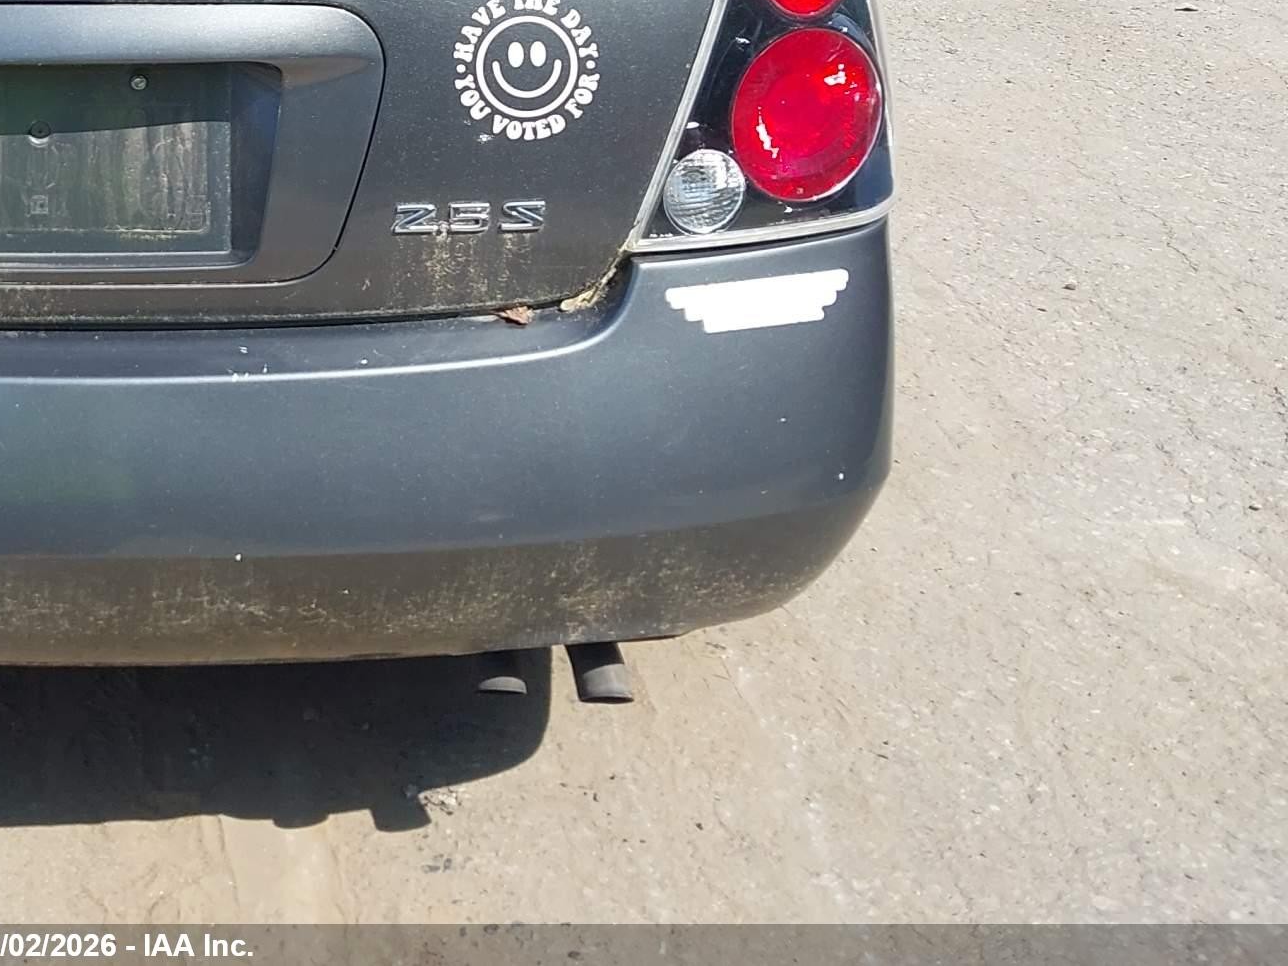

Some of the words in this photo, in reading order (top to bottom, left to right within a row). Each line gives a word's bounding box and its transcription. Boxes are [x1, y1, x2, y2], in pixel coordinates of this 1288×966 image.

[560, 8, 600, 59] DAY
[454, 73, 492, 121] YOU
[492, 113, 567, 141] VOTED
[564, 72, 601, 120] FOR
[498, 200, 547, 234] S
